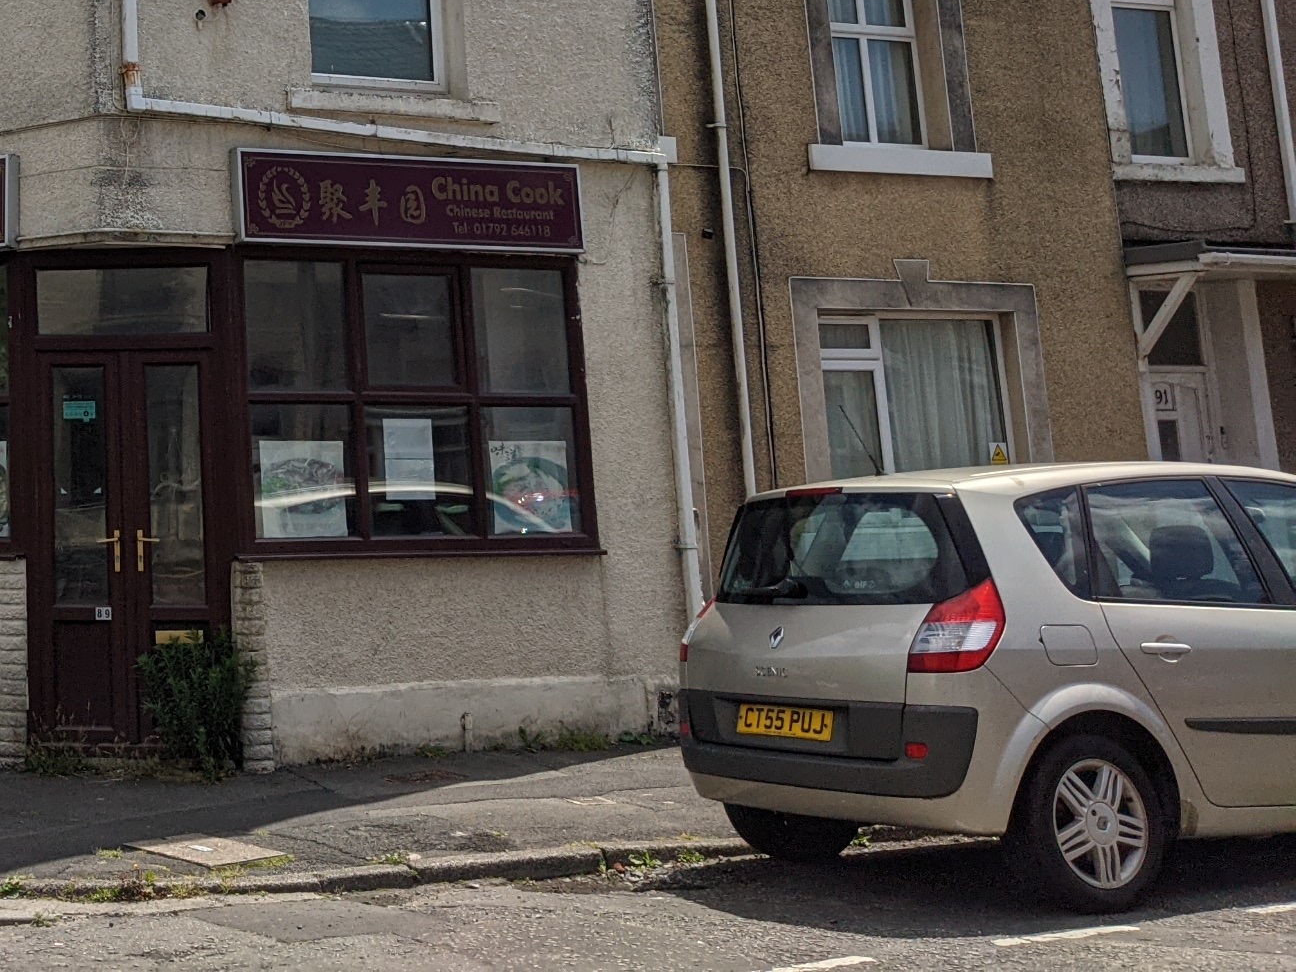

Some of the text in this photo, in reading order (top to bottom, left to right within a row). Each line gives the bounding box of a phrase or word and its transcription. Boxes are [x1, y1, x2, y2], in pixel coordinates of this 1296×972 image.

[432, 176, 565, 205] China Cook
[446, 204, 554, 220] Chinese Restaurant
[473, 223, 507, 236] 01792
[510, 225, 551, 237] 646118
[1155, 389, 1168, 404] 91
[97, 608, 110, 619] 89
[755, 666, 788, 678] SCENIC
[744, 708, 825, 734] CT55 PUJ
